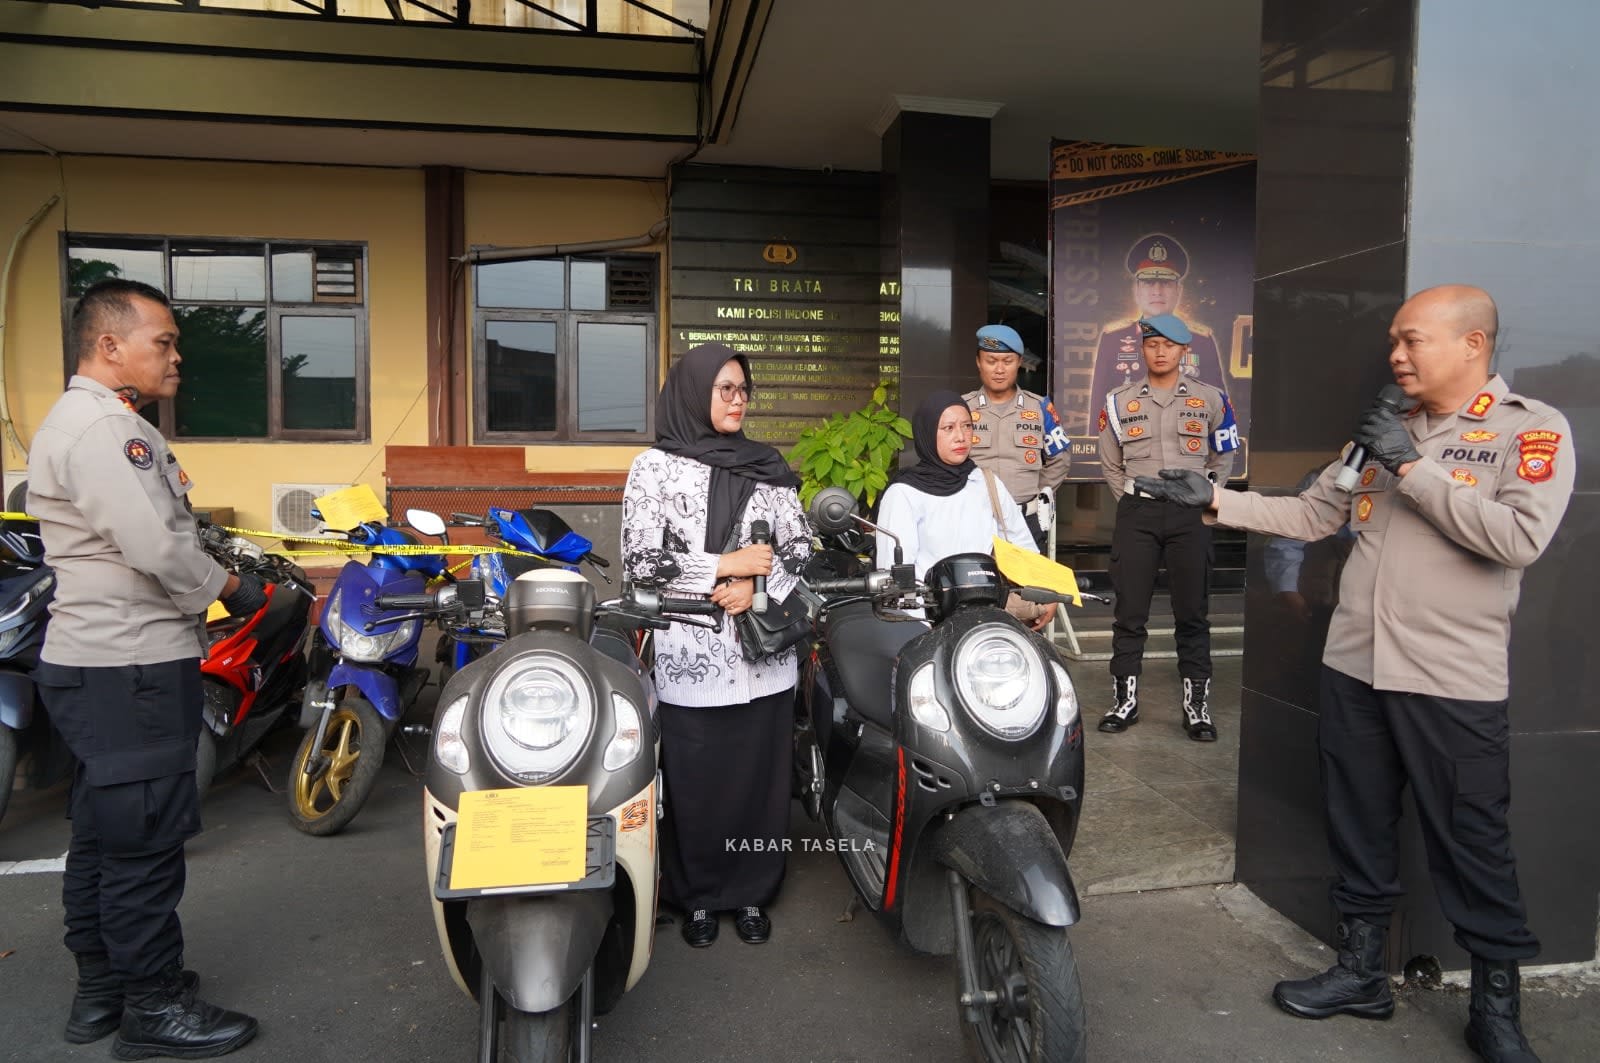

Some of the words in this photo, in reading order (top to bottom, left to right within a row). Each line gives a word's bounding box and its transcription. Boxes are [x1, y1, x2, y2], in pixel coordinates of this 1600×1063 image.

[1070, 157, 1084, 172] DO
[1087, 155, 1108, 171] NOT
[1112, 153, 1145, 169] CROSS
[1153, 148, 1183, 166] CRIME
[1185, 147, 1217, 162] SCENE
[733, 278, 760, 293] TRI
[769, 279, 822, 294] BRATA
[717, 307, 746, 319] KAMI
[748, 308, 782, 320] POLISI
[1180, 411, 1209, 419] POLRI
[1016, 423, 1042, 432] POLRI
[1072, 444, 1097, 455] IRJEN
[1441, 448, 1498, 465] POLRI
[536, 587, 569, 595] HONDA
